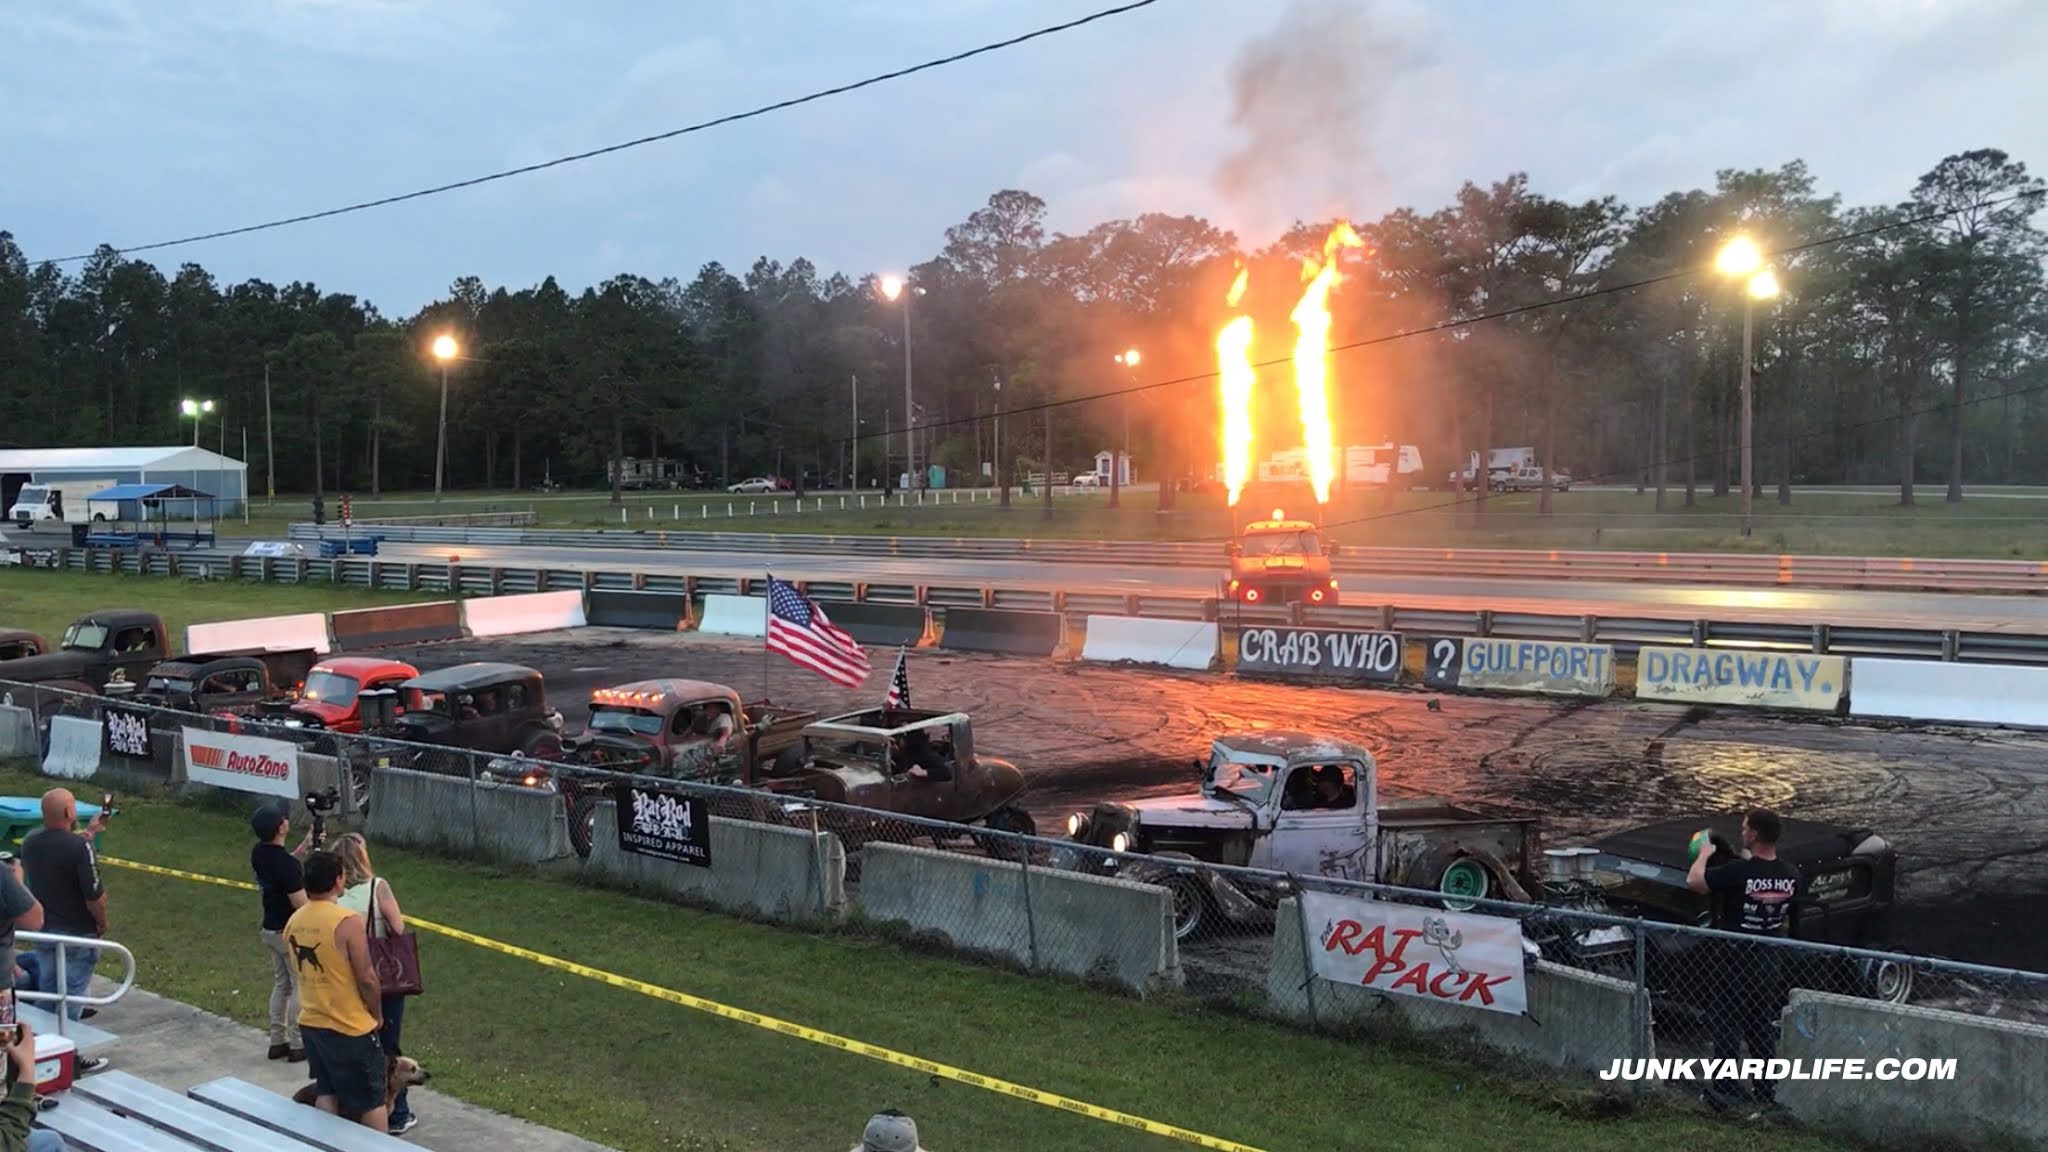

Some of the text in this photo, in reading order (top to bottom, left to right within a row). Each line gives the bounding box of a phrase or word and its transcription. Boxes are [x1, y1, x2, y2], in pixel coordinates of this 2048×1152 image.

[1241, 629, 1832, 694] CRAB WHO ? GULFPORT DRAGWAY.
[226, 751, 289, 780] AutoZone
[623, 831, 662, 849] INSPIRED
[665, 840, 706, 858] APPAREL
[1745, 878, 1773, 895] BOSS
[1325, 919, 1424, 961] RAT
[1361, 957, 1513, 1006] PACK
